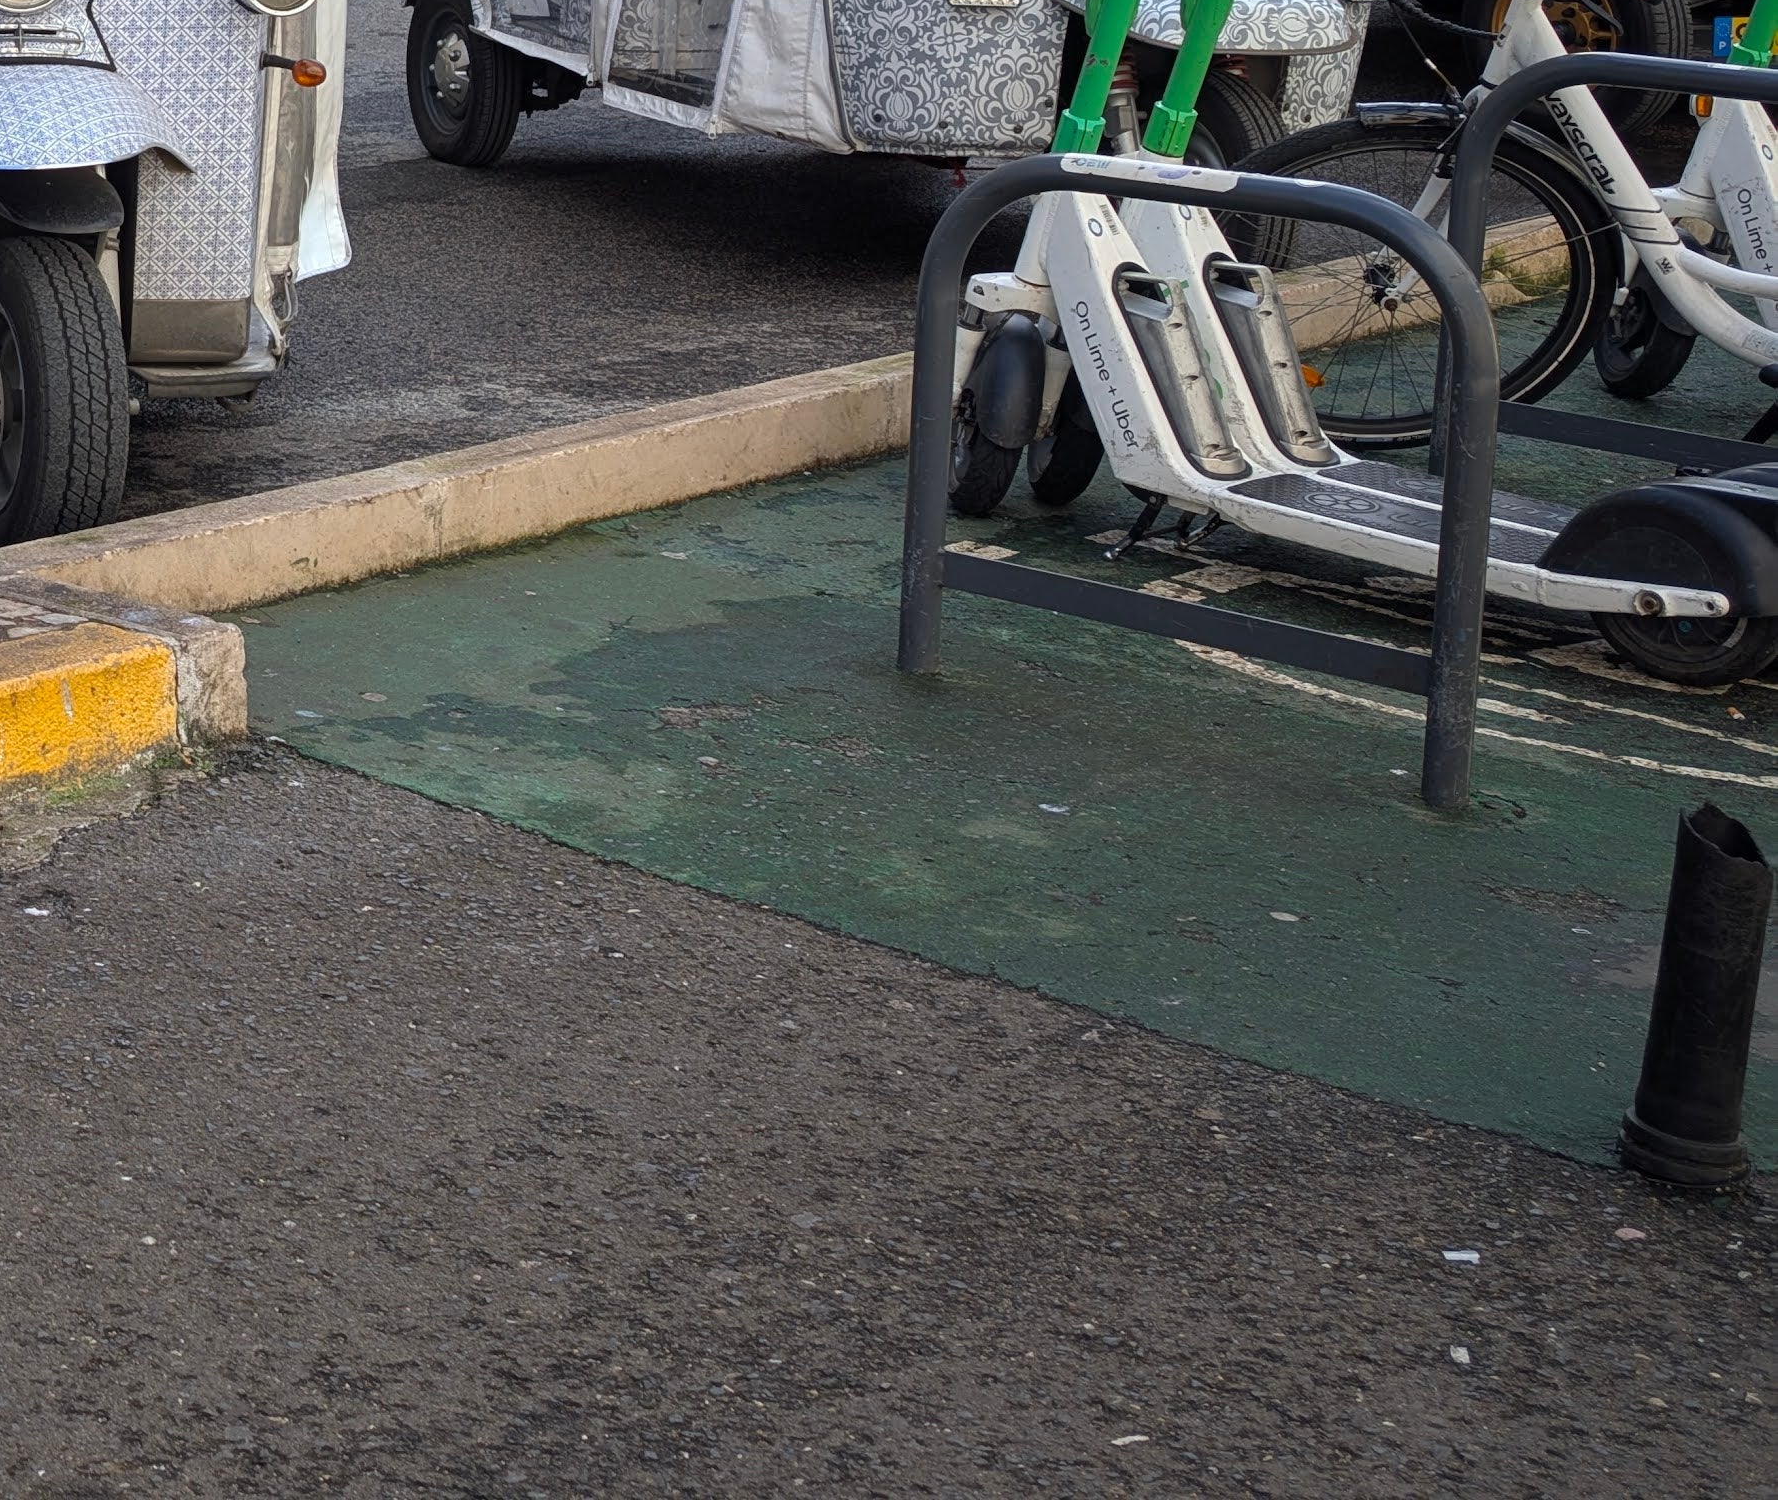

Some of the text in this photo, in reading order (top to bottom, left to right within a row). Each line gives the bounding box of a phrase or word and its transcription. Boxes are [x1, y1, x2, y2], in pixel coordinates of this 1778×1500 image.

[1737, 188, 1754, 216] On
[1744, 216, 1767, 260] Lime
[1075, 300, 1092, 332] On
[1084, 332, 1110, 382] Lime
[1111, 399, 1140, 448] Uber
